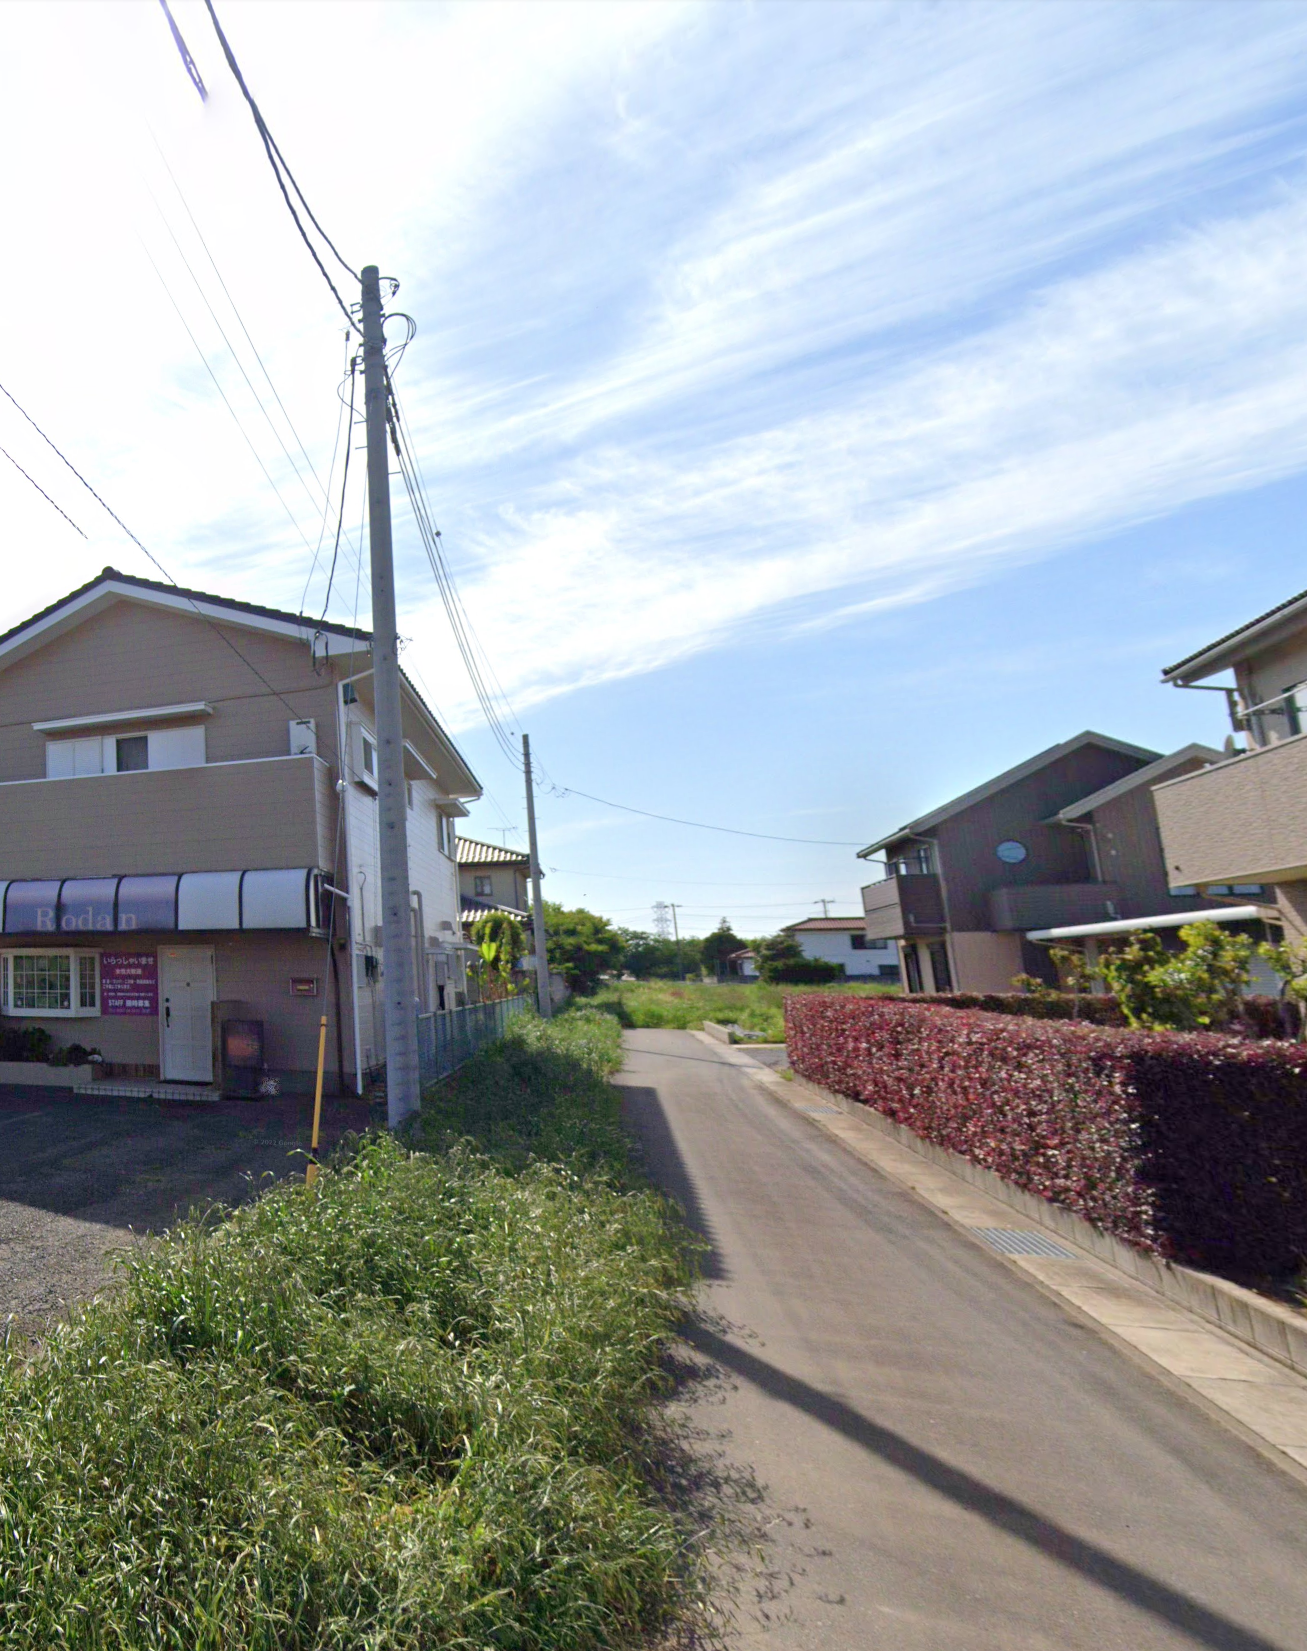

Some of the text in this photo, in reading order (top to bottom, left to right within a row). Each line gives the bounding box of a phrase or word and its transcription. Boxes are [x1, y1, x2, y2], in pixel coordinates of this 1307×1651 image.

[36, 906, 137, 931] Rodan
[103, 956, 154, 965] いらっしゃいませ
